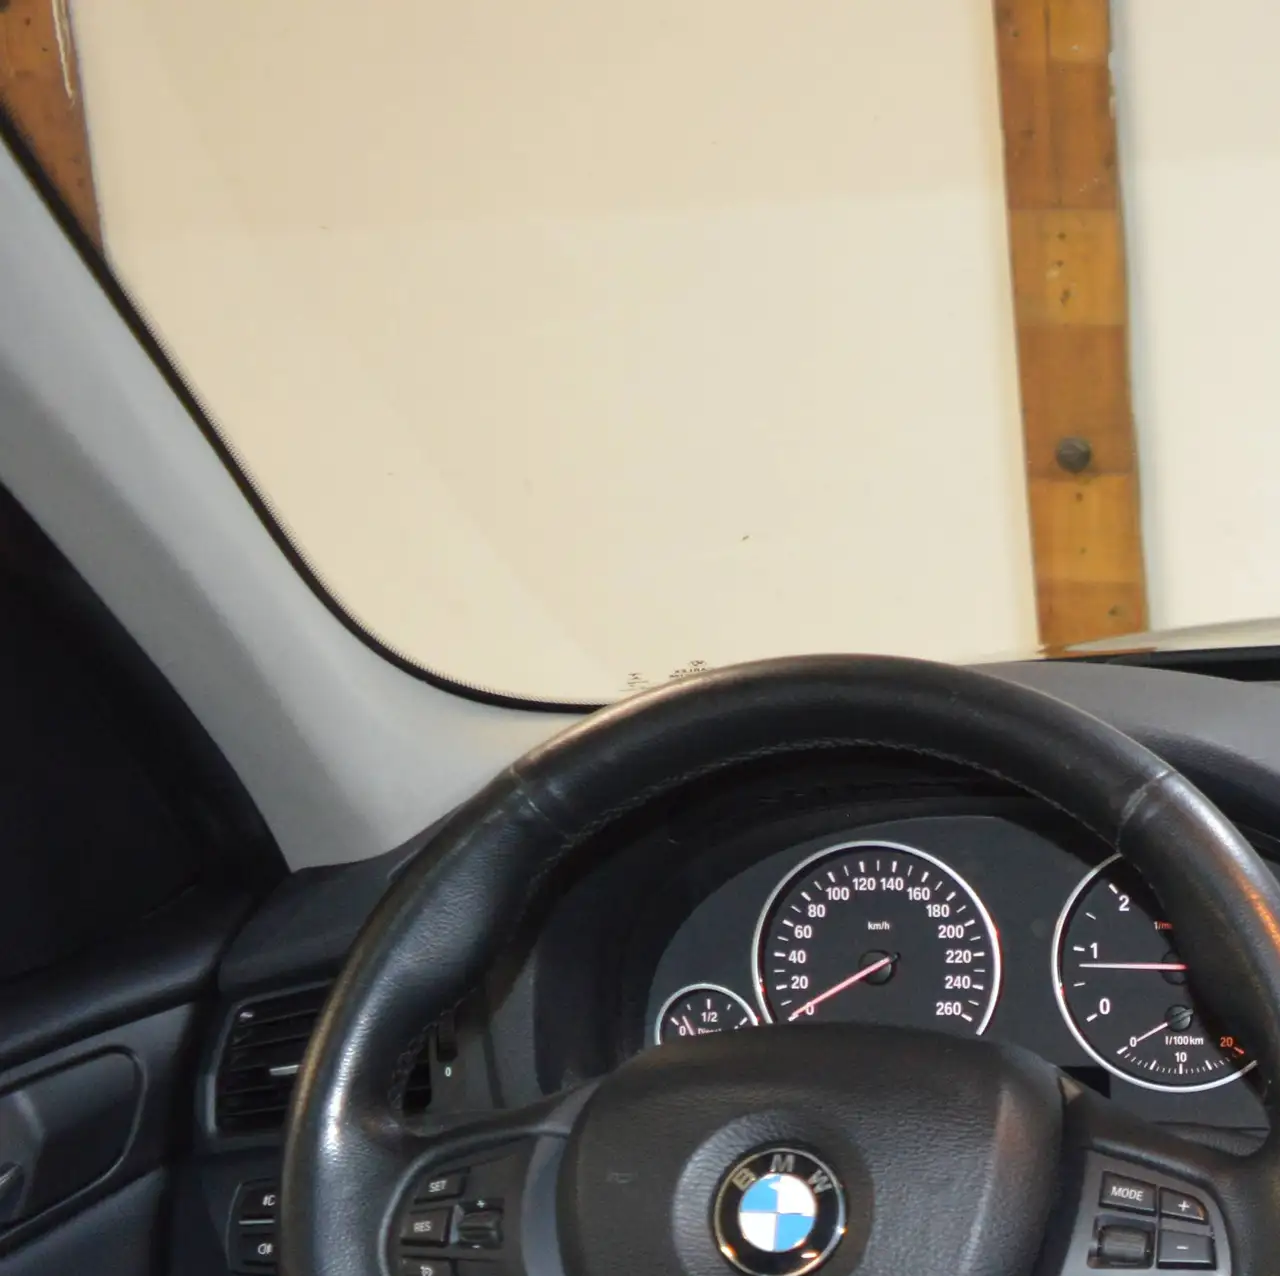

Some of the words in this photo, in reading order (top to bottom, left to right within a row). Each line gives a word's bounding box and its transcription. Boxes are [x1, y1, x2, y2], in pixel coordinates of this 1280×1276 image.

[853, 878, 875, 890] 120
[880, 877, 904, 890] 140
[826, 887, 850, 901] 100
[907, 887, 930, 901] 160
[1119, 895, 1130, 911] 2
[808, 904, 826, 918] 80
[926, 904, 949, 917] 180
[794, 925, 812, 939] 60
[868, 921, 890, 931] km/h
[938, 925, 964, 939] 200
[788, 950, 806, 964] 40
[945, 950, 971, 964] 220
[1090, 942, 1098, 959] 1
[791, 976, 808, 989] 20
[945, 975, 971, 989] 240
[936, 1002, 961, 1016] 260
[1099, 998, 1110, 1015] 0
[701, 1012, 718, 1022] 1/2
[1129, 1036, 1137, 1047] 0
[1220, 1036, 1233, 1047] 20
[1175, 1052, 1187, 1062] 10
[732, 1154, 834, 1194] BMW
[428, 1180, 447, 1193] SET
[1111, 1186, 1144, 1201] MODE
[413, 1221, 432, 1233] RES
